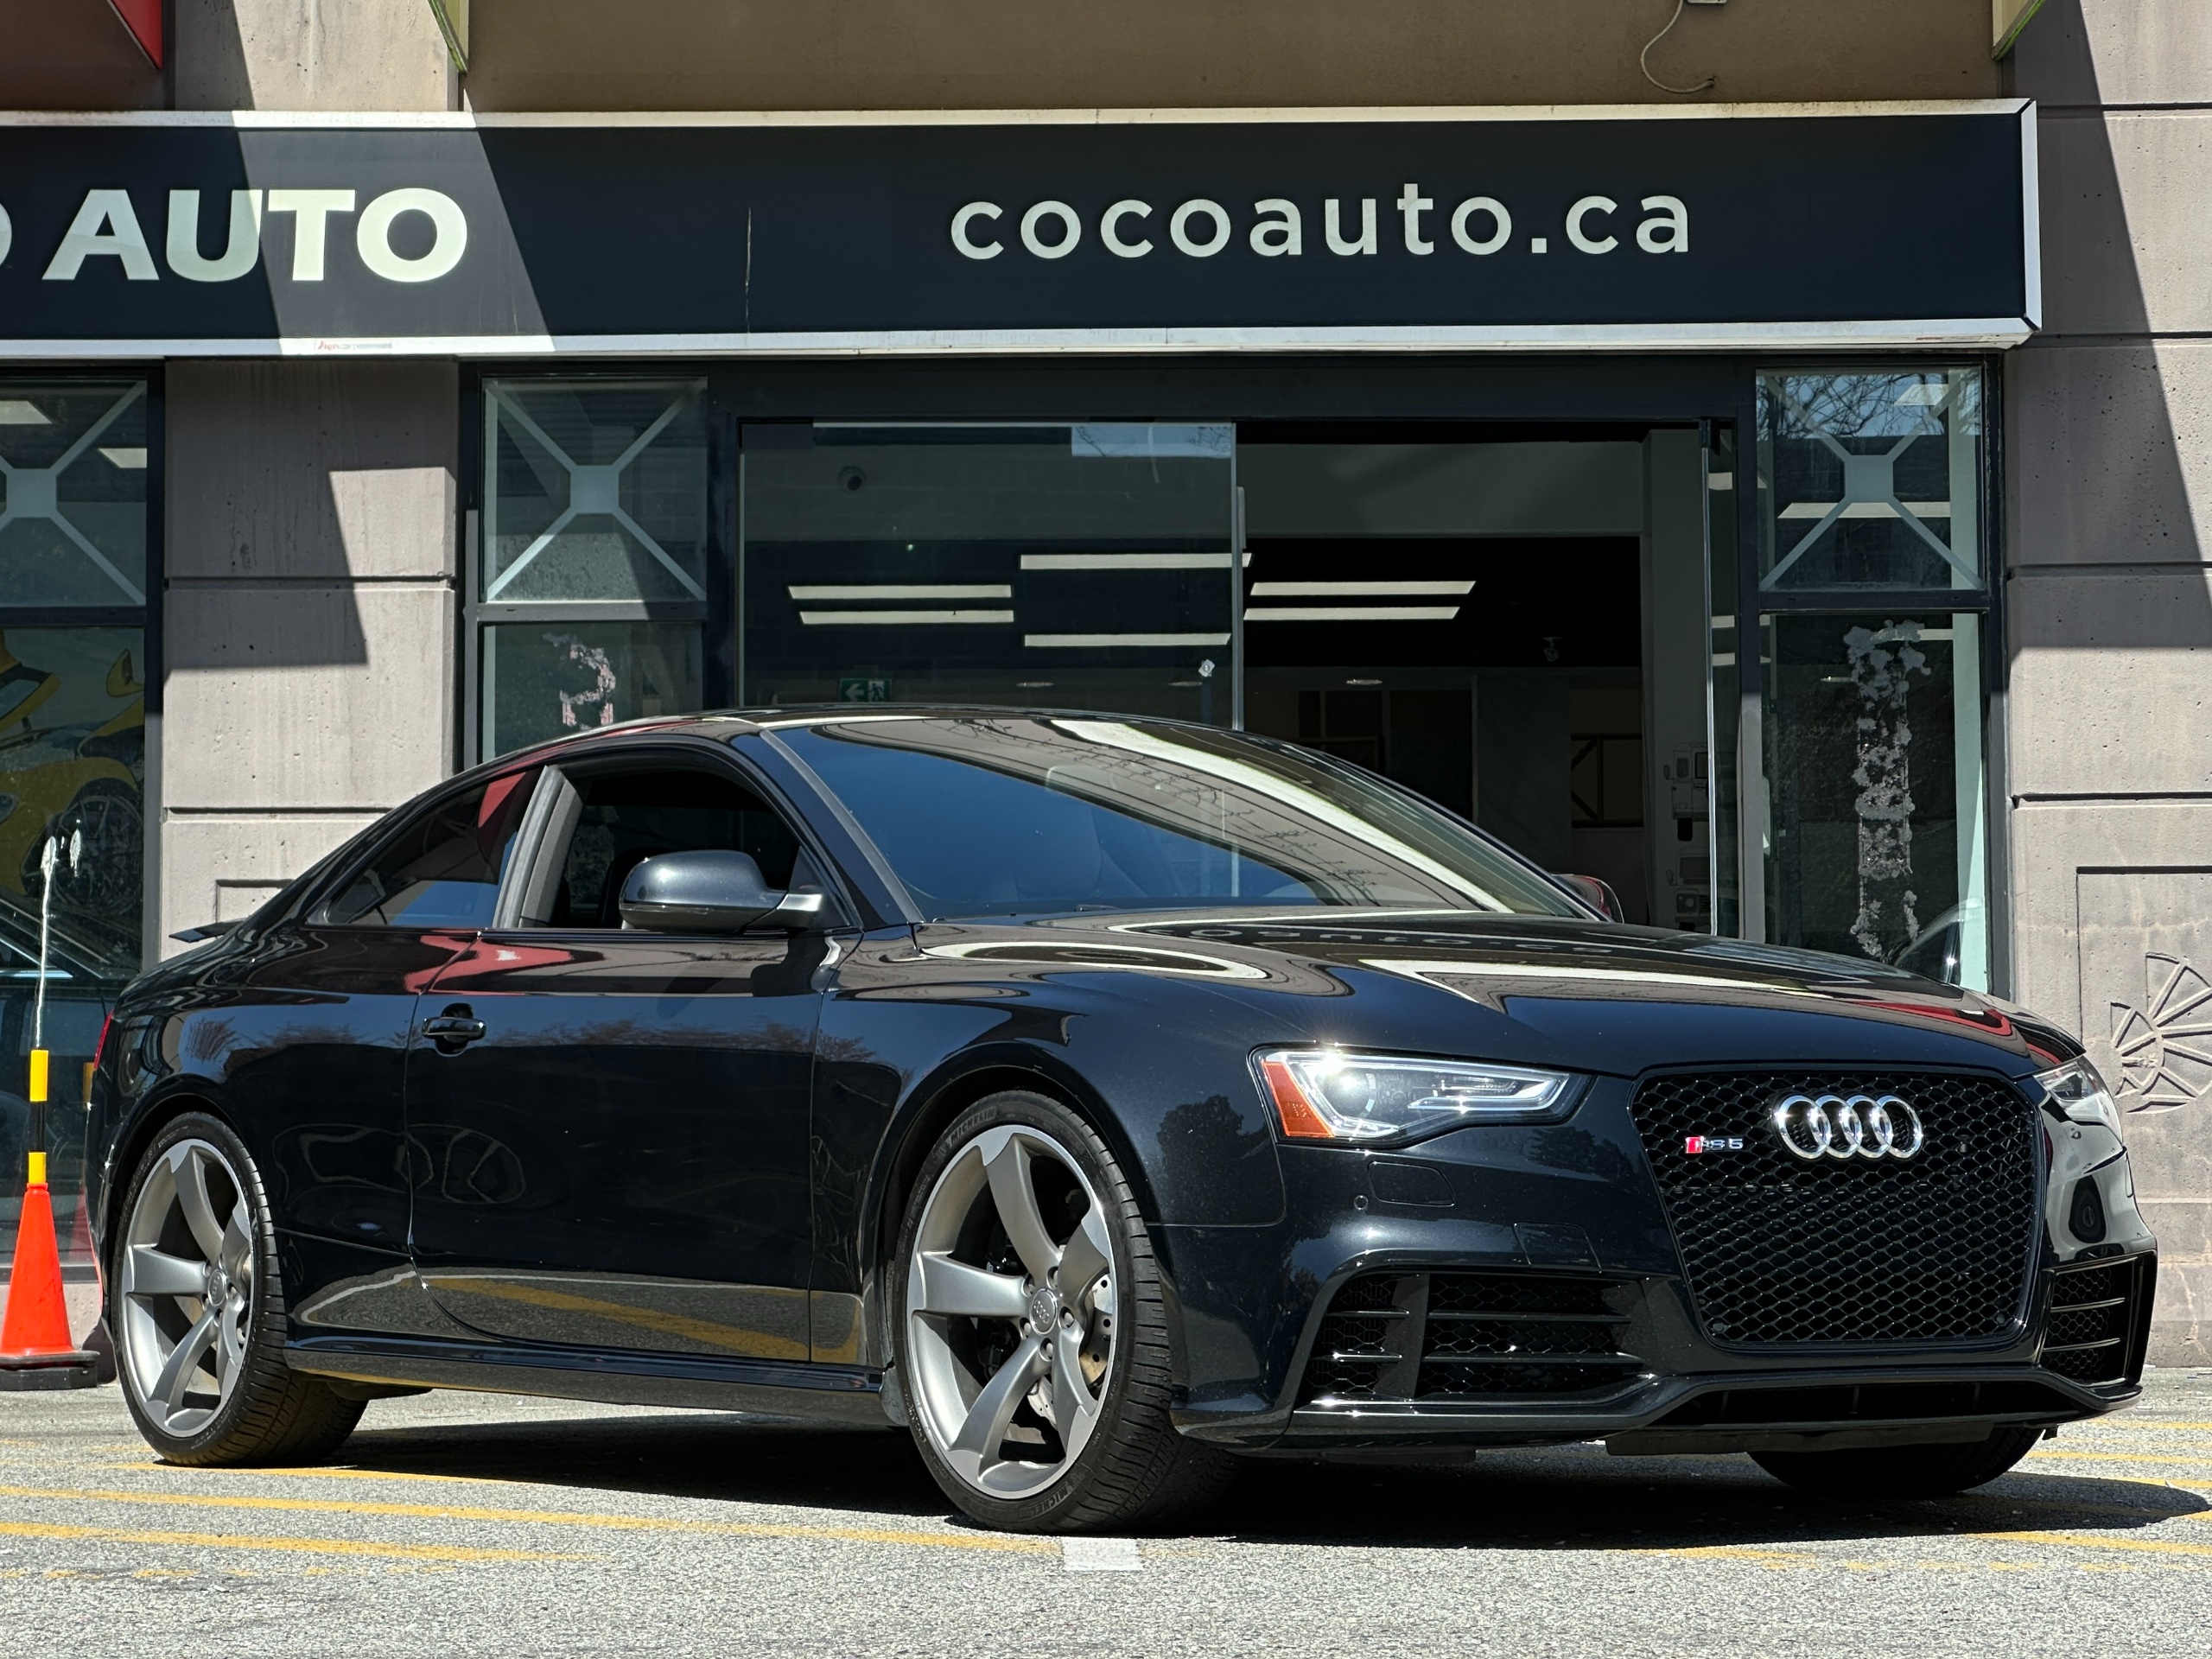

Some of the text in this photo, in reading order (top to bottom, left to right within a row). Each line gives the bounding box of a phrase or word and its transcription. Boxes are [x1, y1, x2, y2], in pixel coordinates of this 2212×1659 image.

[41, 188, 467, 283] AUTO
[950, 183, 1690, 260] cocoauto.ca
[950, 1107, 996, 1143] MICHELIN
